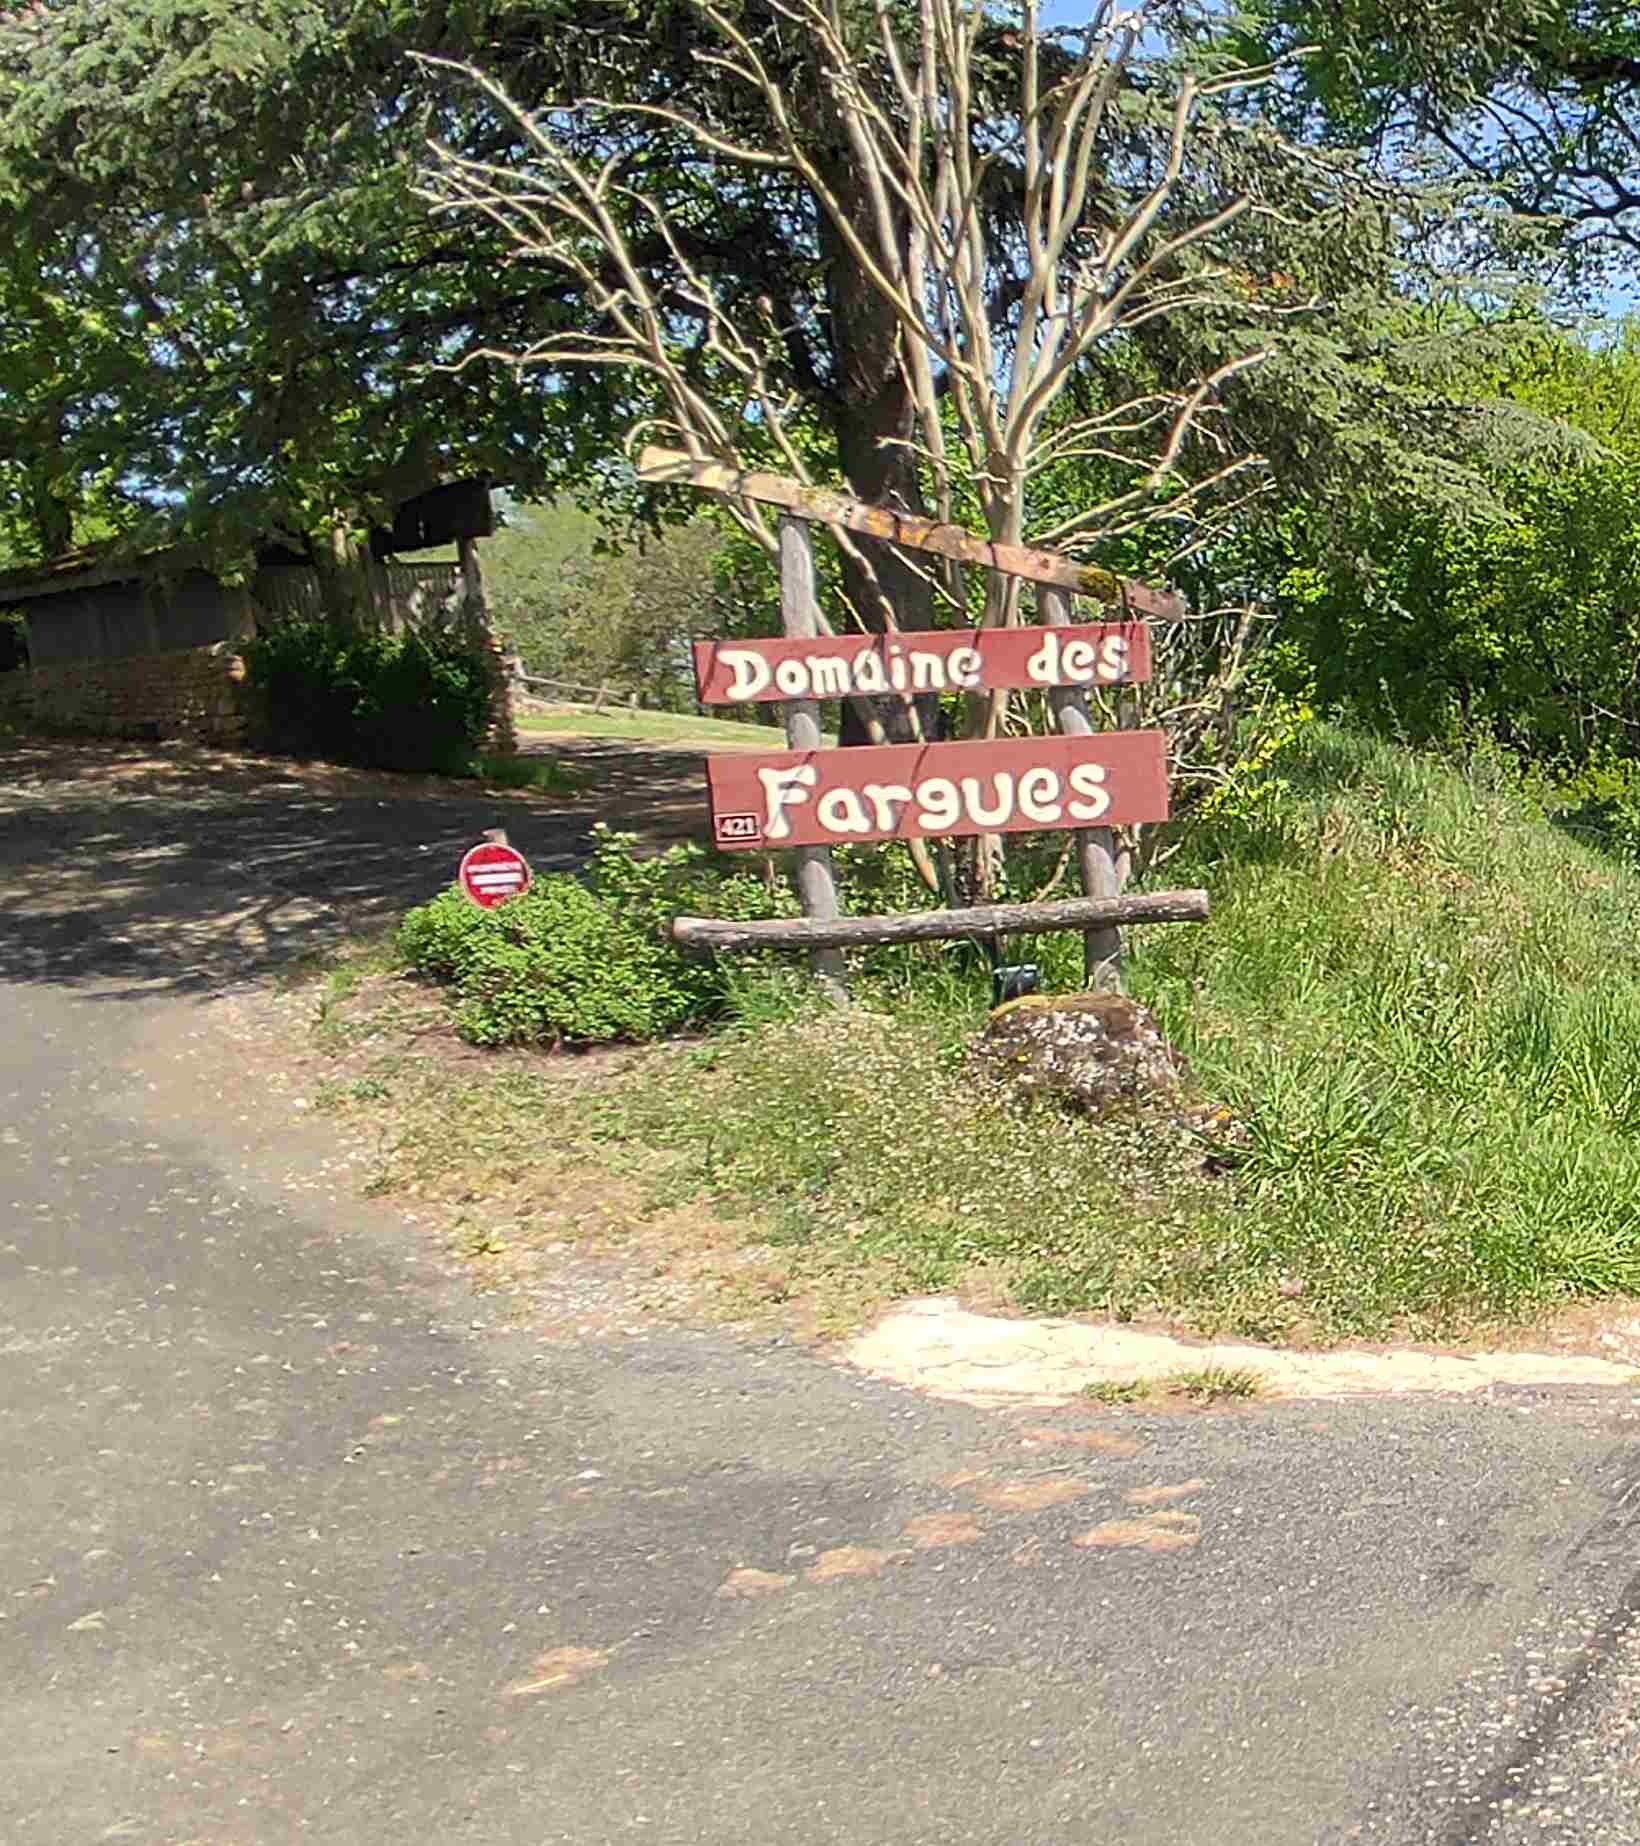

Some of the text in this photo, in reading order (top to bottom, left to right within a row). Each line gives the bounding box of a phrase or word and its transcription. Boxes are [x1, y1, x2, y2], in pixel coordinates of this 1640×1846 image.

[720, 633, 1129, 701] Domaine des
[721, 817, 755, 836] 421
[758, 763, 1111, 839] Fargues
